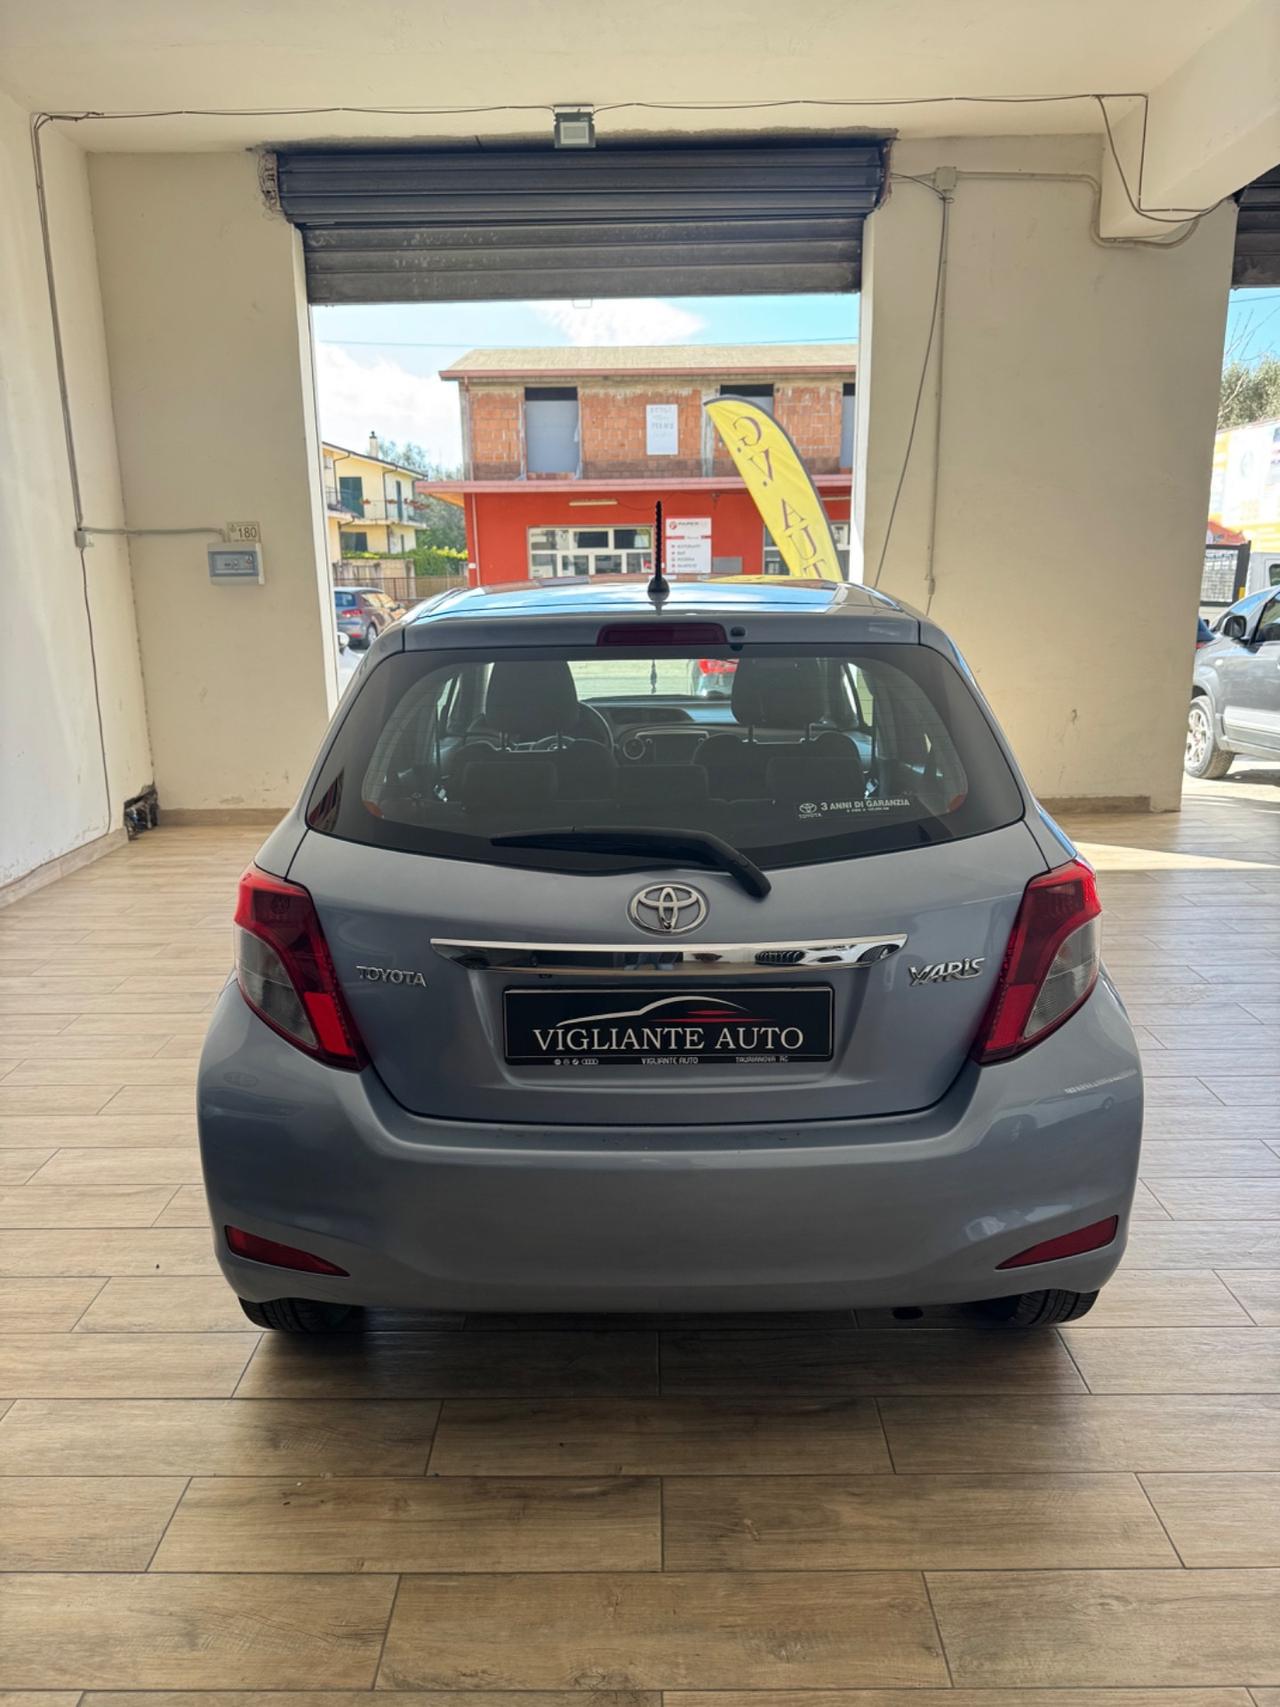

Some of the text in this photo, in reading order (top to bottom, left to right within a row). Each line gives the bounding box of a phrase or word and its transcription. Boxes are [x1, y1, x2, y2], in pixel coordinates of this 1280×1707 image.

[238, 527, 257, 538] 180
[820, 802, 829, 811] 3
[830, 801, 852, 810] ANNI
[854, 800, 864, 808] DI
[866, 799, 910, 808] GARANZIA
[356, 965, 427, 988] TOYOTA
[532, 1027, 804, 1051] VIGLIANTE AUTO
[641, 1056, 699, 1065] VIGLIANTE AUTO
